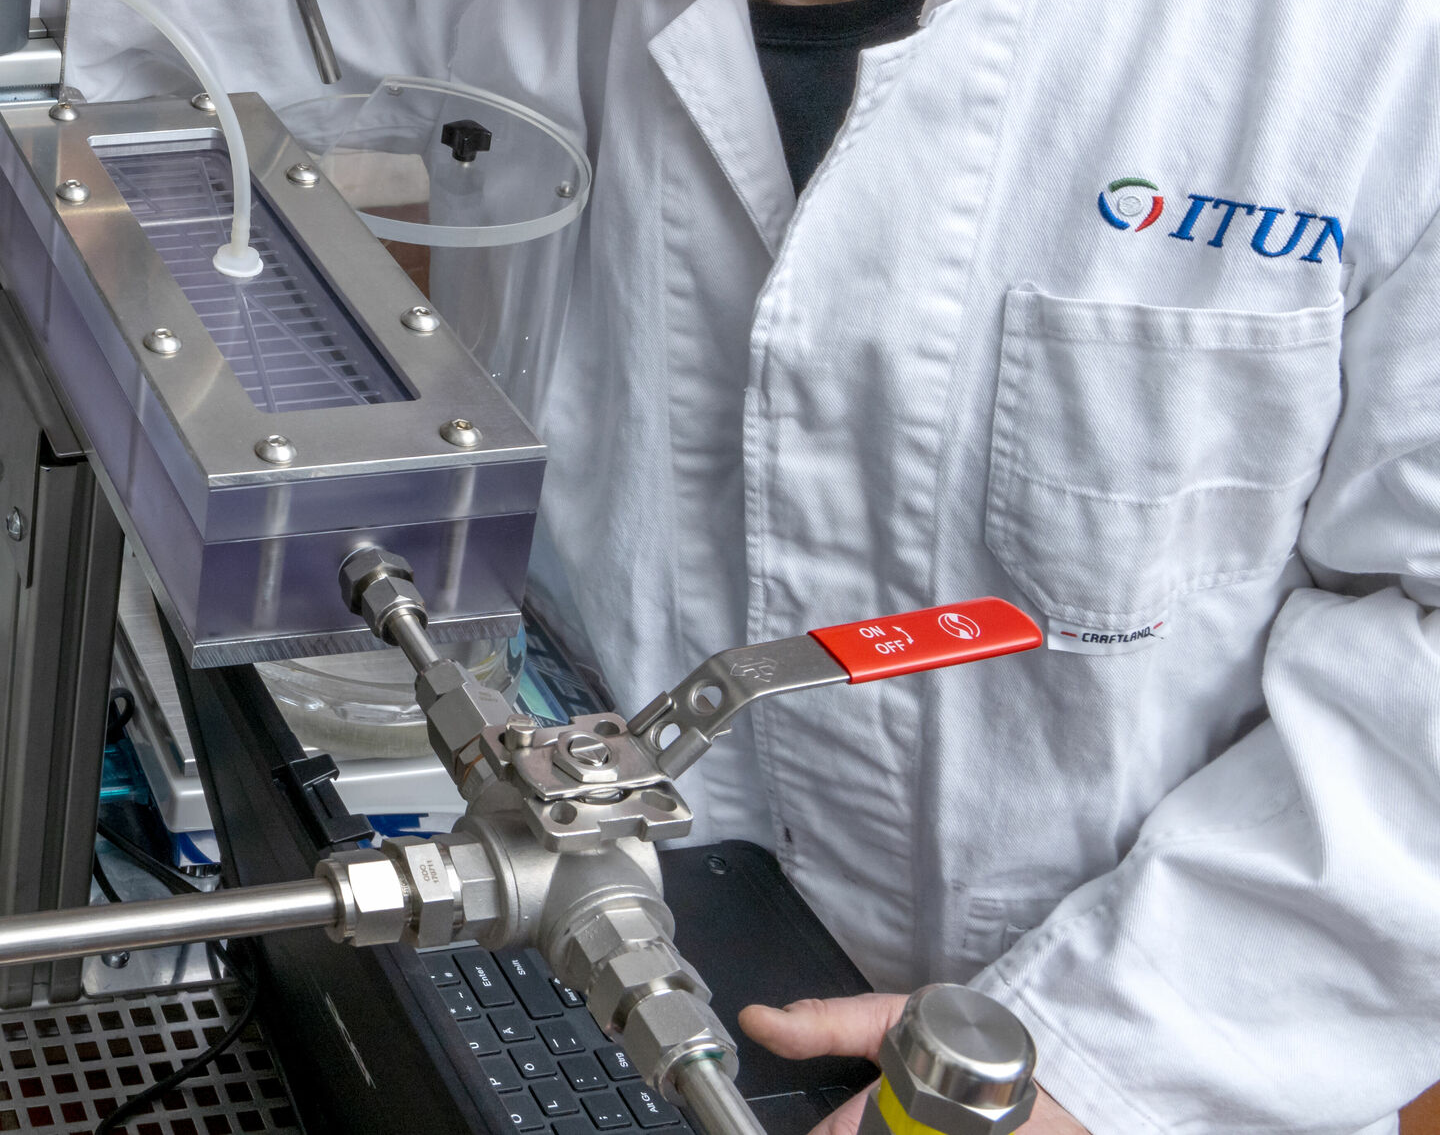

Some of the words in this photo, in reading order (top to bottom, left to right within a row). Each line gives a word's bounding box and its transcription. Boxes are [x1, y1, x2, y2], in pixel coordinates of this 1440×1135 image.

[858, 625, 886, 639] ON
[1081, 626, 1151, 644] CRAFTLAND
[874, 639, 906, 655] OFF
[475, 966, 492, 987] Enter
[489, 1077, 501, 1086] P
[547, 1100, 558, 1108] L
[510, 1113, 522, 1124] O
